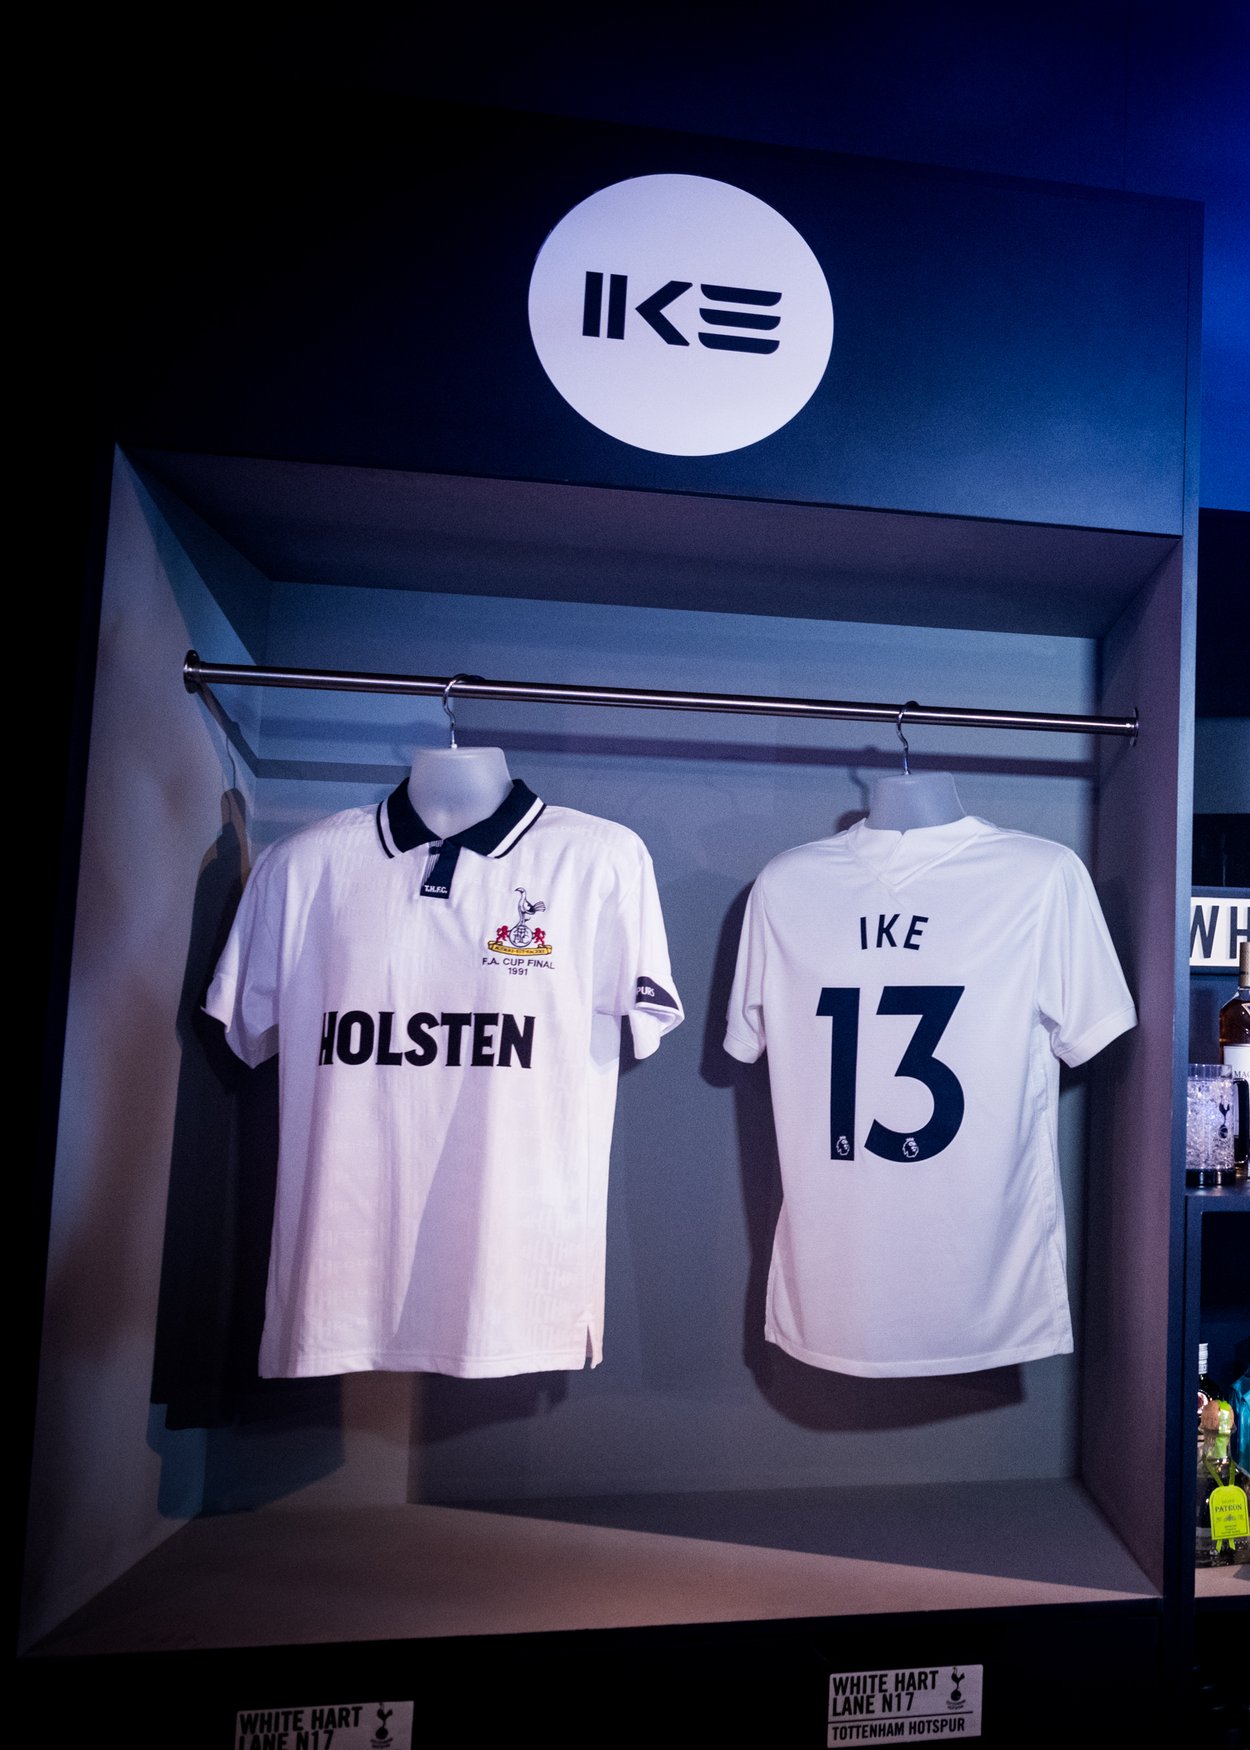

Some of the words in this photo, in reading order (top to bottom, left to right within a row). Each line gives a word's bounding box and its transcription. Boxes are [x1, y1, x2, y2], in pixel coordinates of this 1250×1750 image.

[582, 271, 783, 354] IKE
[860, 914, 929, 950] IKE
[503, 957, 525, 967] CUP
[527, 959, 556, 970] FINAL
[508, 967, 529, 976] 1991
[319, 1010, 536, 1069] HOLSTEN
[816, 985, 966, 1163] 13
[832, 1674, 888, 1696] WHITE
[895, 1671, 938, 1692] HART
[832, 1695, 875, 1717] LANE
[882, 1692, 914, 1713] N17
[240, 1711, 304, 1735] WHITE
[311, 1706, 363, 1730] HART
[832, 1722, 904, 1741] TOTTENHAM
[908, 1718, 965, 1735] HOTSPUR
[239, 1733, 289, 1750] LANE
[296, 1729, 334, 1750] N17
